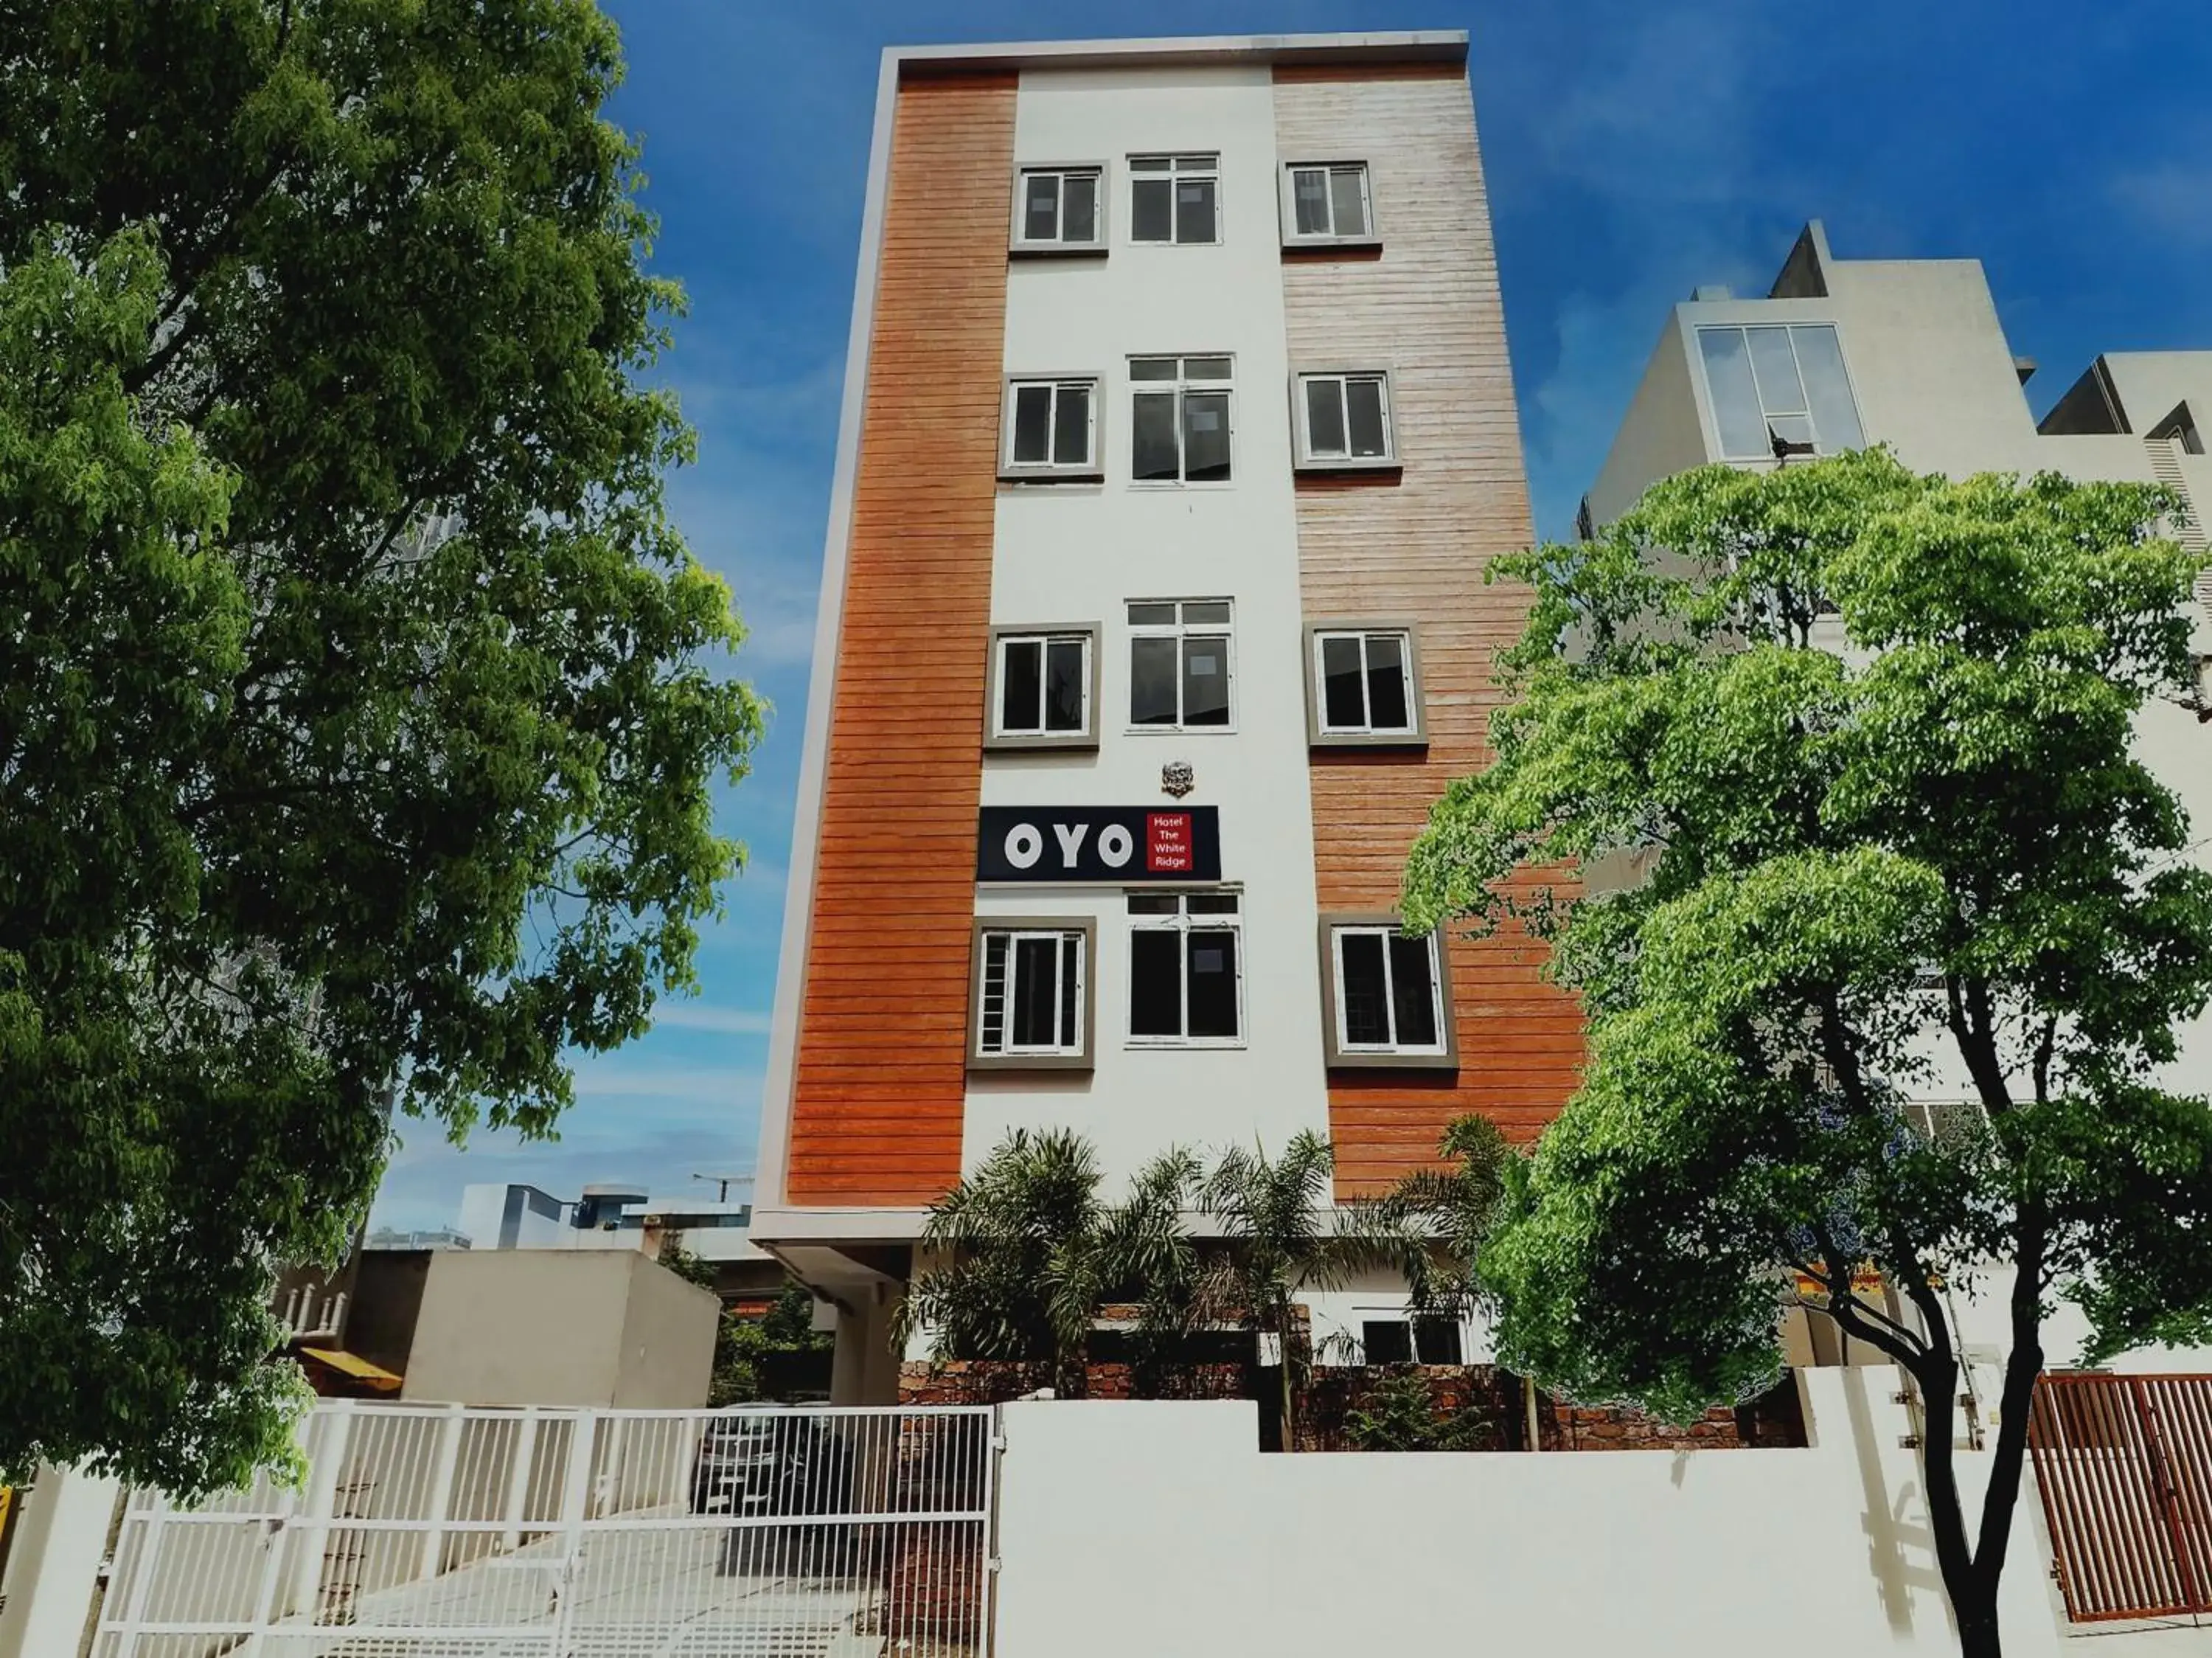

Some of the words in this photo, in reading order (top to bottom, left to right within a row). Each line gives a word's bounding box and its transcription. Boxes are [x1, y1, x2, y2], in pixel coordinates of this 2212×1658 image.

[1154, 816, 1183, 826] Hotel
[1159, 830, 1179, 839] The
[1004, 823, 1133, 869] OYO
[1155, 843, 1185, 853] White
[1155, 856, 1185, 867] Ridge
